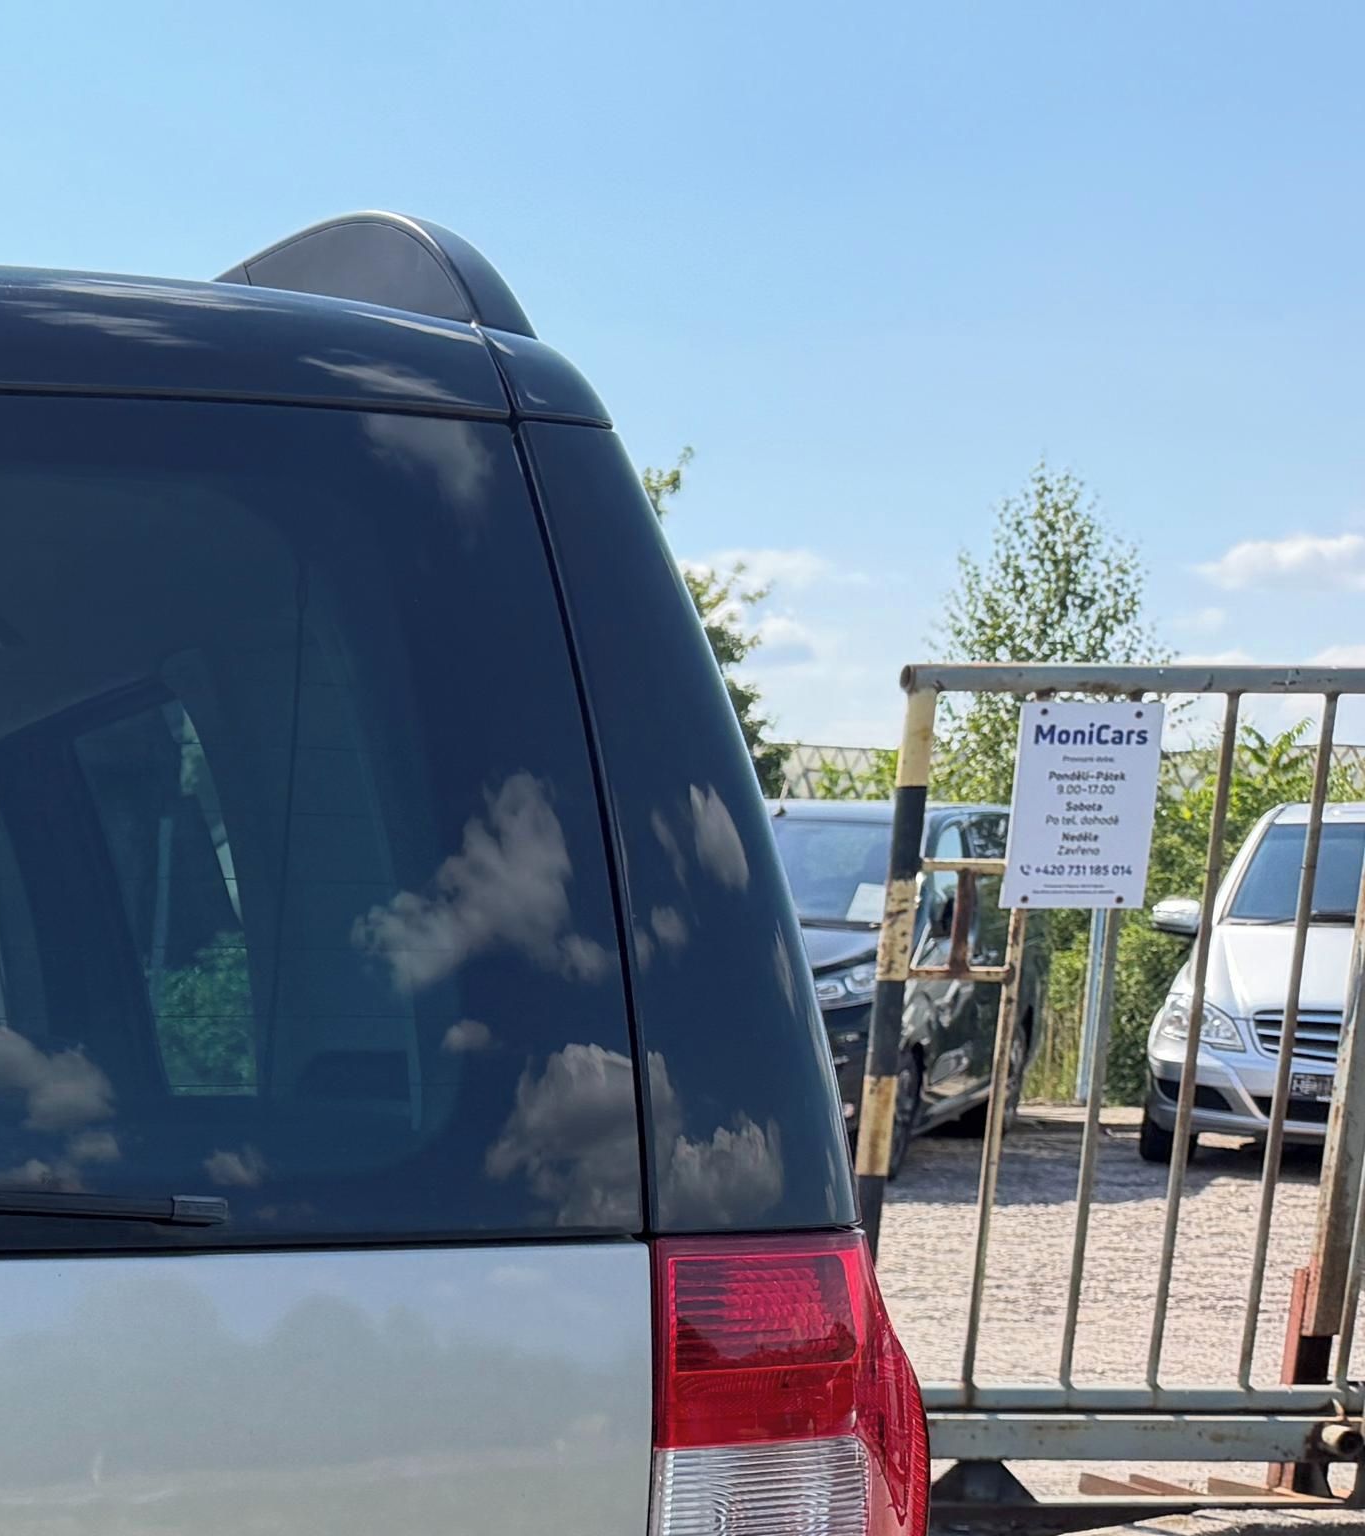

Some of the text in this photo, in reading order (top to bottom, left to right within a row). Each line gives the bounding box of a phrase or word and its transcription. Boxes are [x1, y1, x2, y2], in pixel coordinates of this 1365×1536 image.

[1034, 722, 1149, 746] MoniCars
[1065, 801, 1103, 812] Sobota
[1067, 864, 1087, 876] 731
